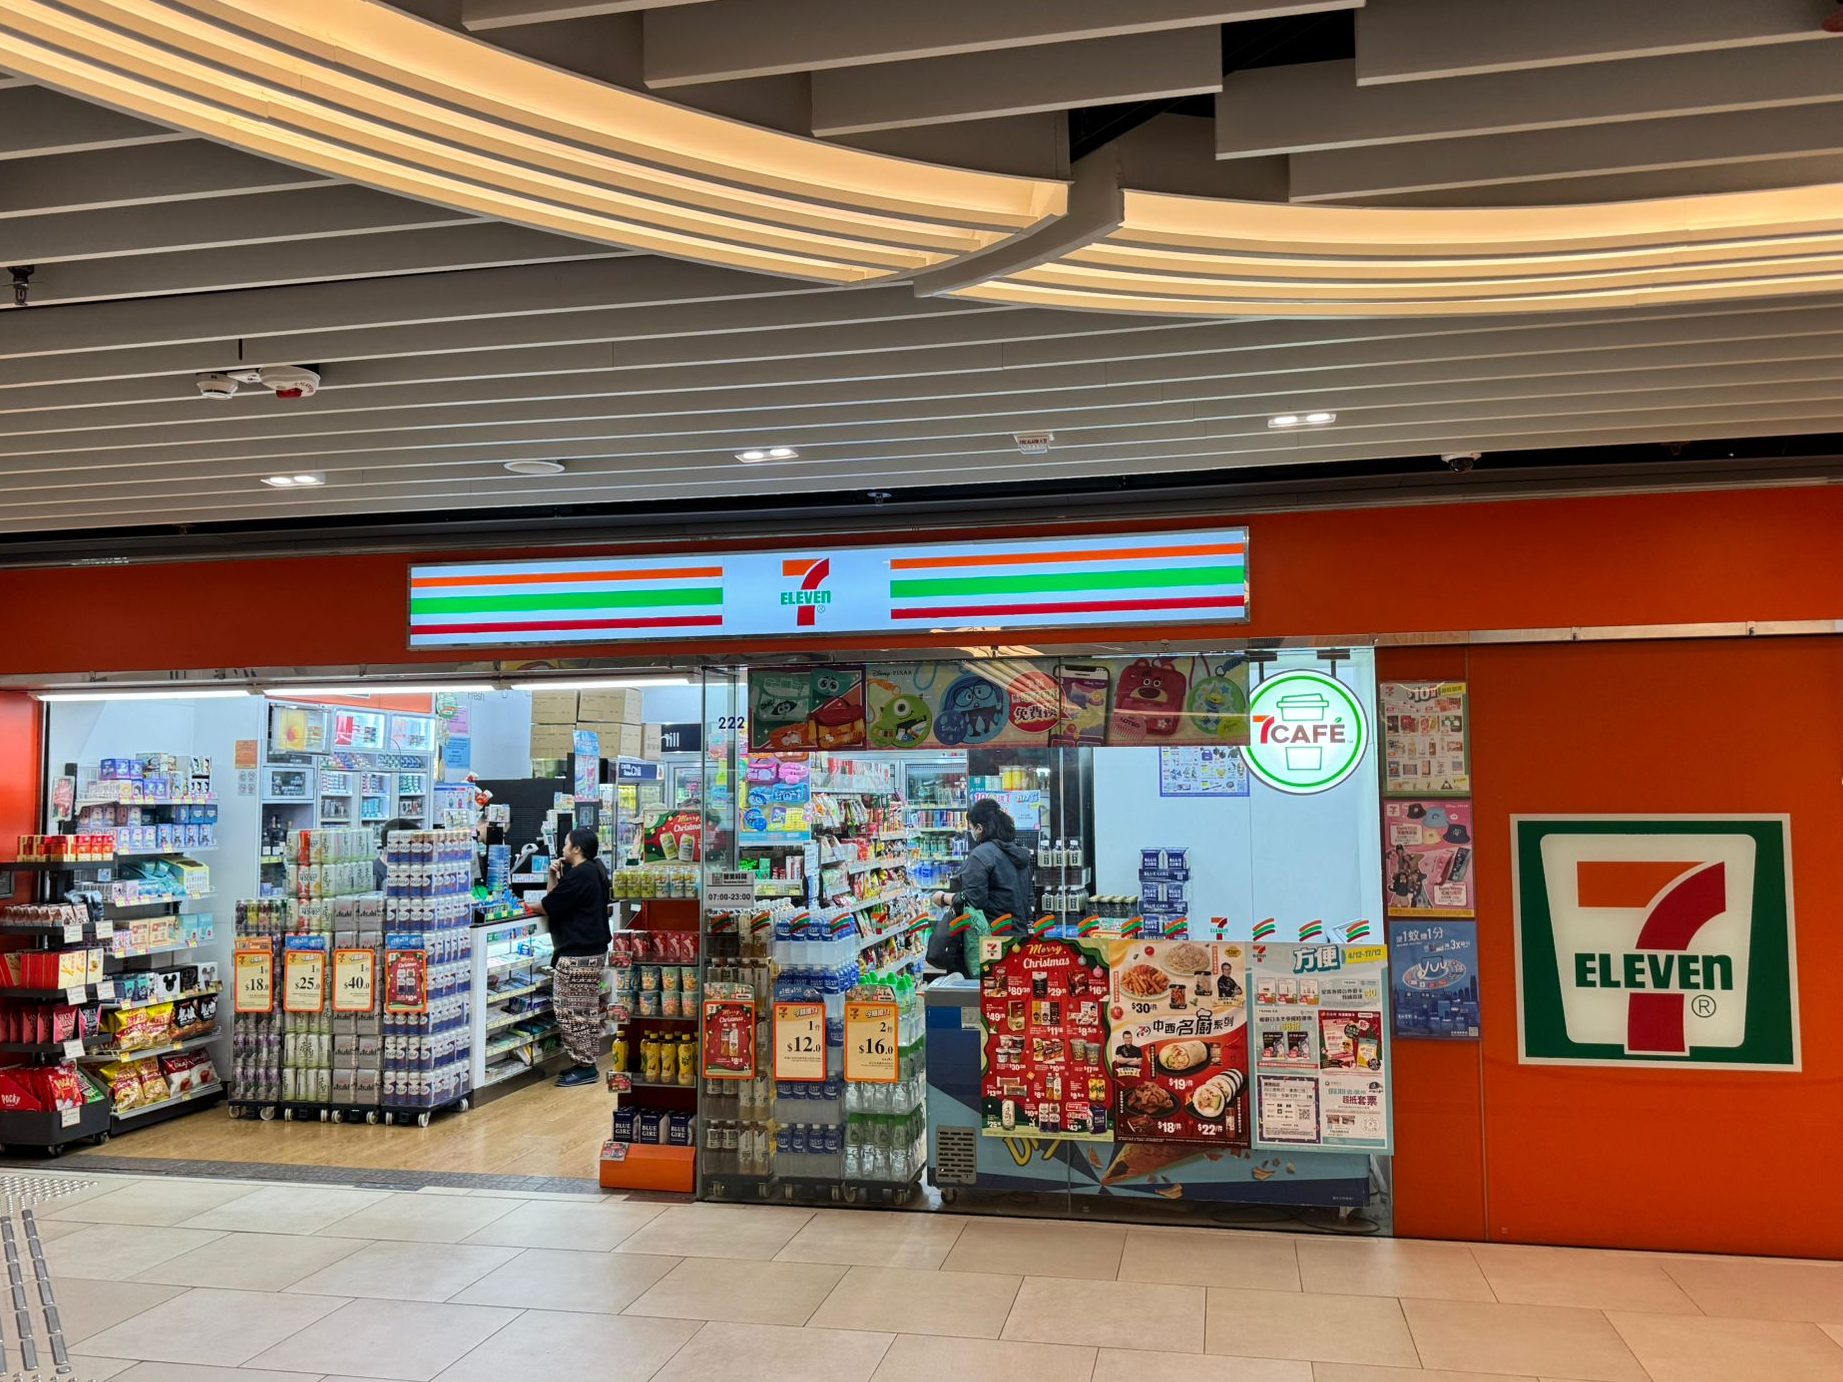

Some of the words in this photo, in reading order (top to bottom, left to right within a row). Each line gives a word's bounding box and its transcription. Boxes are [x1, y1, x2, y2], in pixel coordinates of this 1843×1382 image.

[718, 716, 745, 730] 222
[1023, 957, 1070, 969] Christmas
[1294, 945, 1339, 973] 方便
[1153, 1016, 1234, 1036] 中西名廚系列
[787, 1036, 821, 1052] $12.0
[859, 1038, 894, 1054] $16.0
